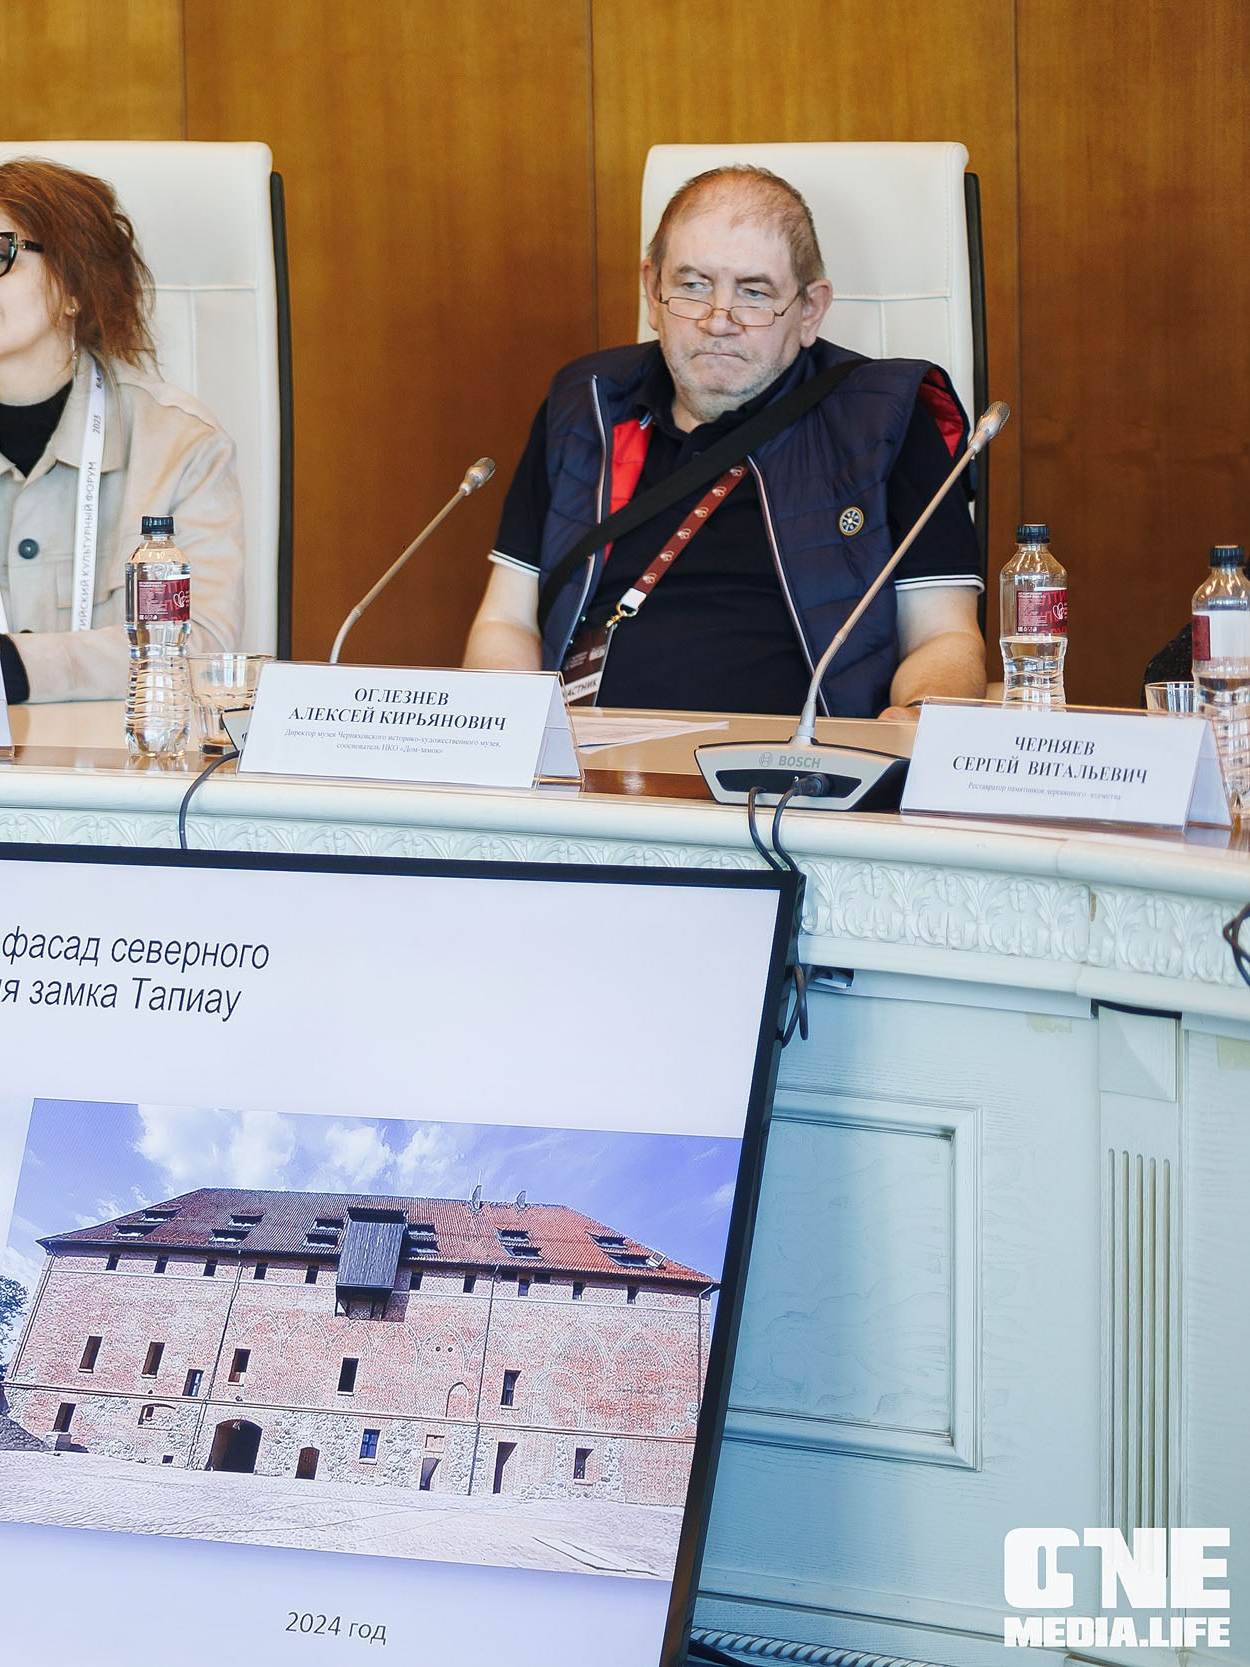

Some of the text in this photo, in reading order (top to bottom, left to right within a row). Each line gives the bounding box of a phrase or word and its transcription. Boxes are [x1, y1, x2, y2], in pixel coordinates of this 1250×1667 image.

[86, 461, 96, 502] ФОРУМ
[82, 503, 94, 576] КУЛЬТУРНЫЙ
[78, 578, 90, 631] ИЙСКИЙ
[354, 688, 449, 706] ОГЛЕЗНЕВ
[284, 728, 317, 738] Директор
[288, 706, 507, 731] АЛЕКСЕЙ КИРЬЯНОВИЧ
[778, 755, 821, 768] BOSCH
[1015, 736, 1095, 756] ЧЕРНЯЕВ
[952, 755, 1148, 784] СЕРГЕЙ ВИТАЛЬЕВИЧ
[1, 926, 101, 966] фасад
[110, 935, 271, 974] северного
[28, 978, 119, 1009] замка
[131, 976, 243, 1023] Тапиау
[285, 1611, 387, 1646] 2024 год
